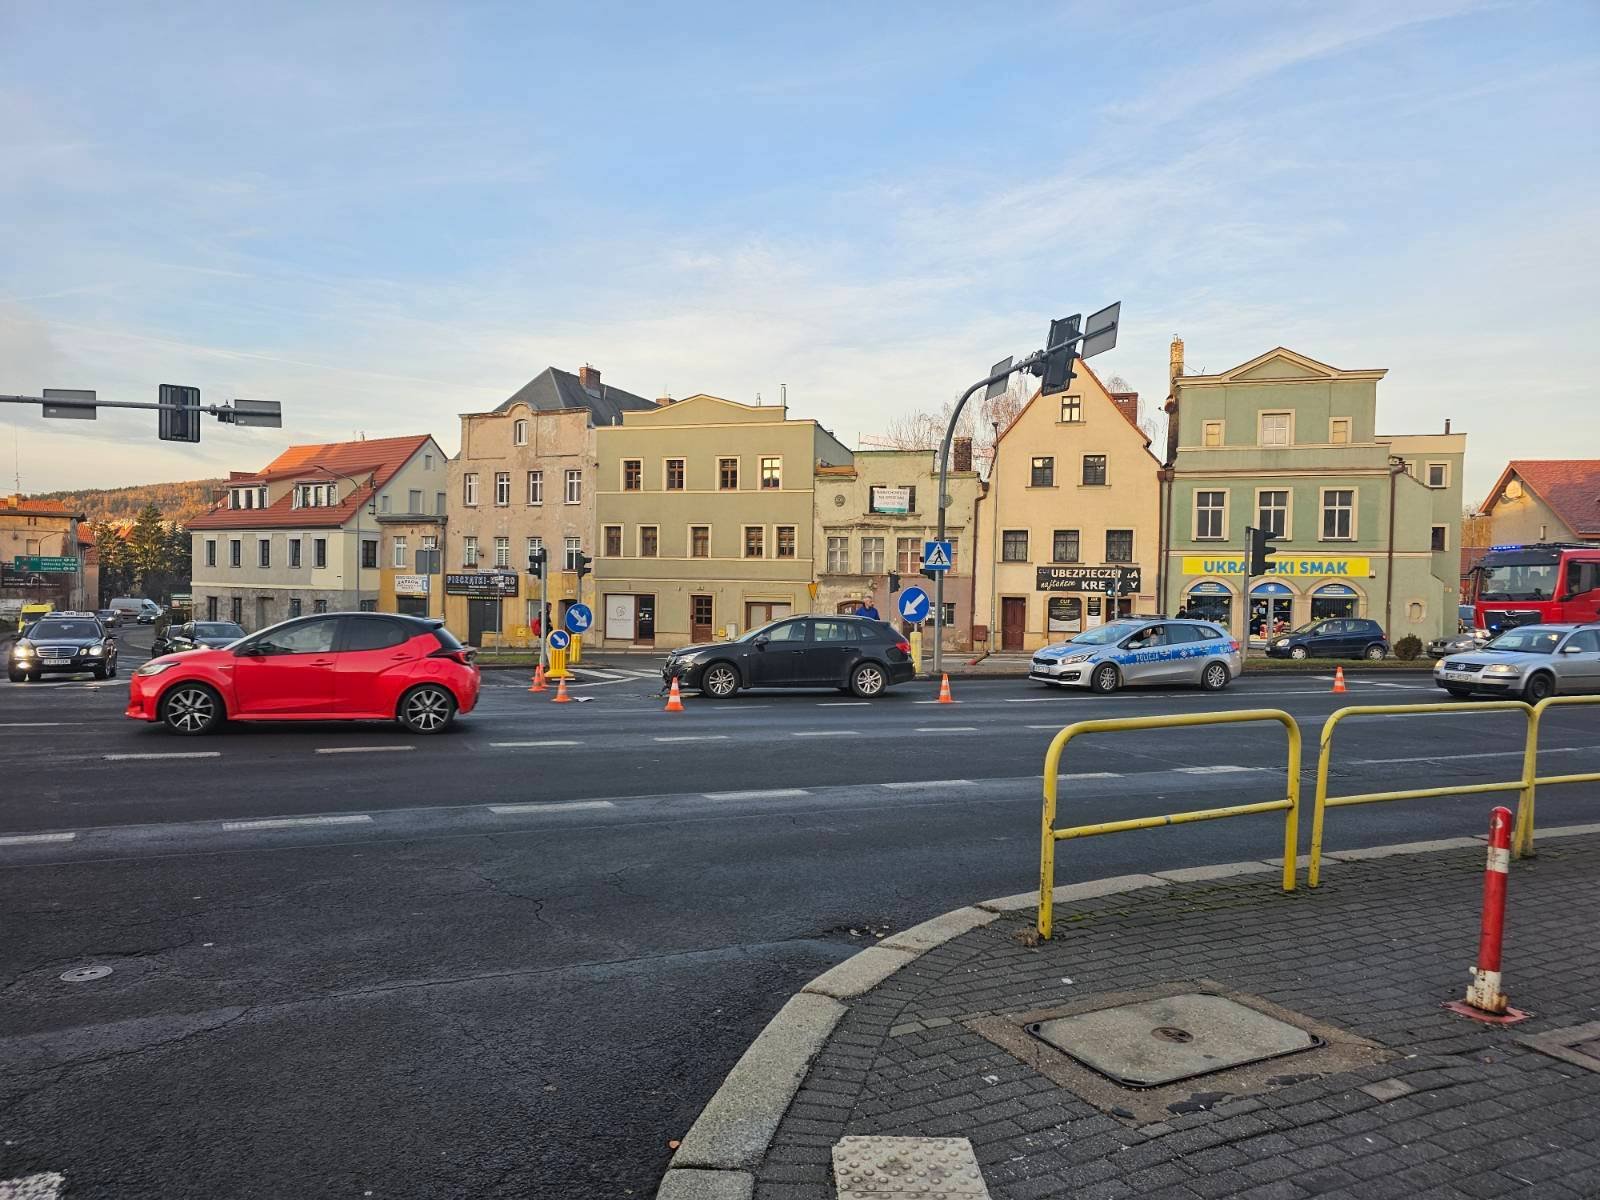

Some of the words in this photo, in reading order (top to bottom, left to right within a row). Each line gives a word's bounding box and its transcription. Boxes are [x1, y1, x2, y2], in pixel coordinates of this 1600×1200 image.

[1204, 560, 1294, 574] UKRAKI
[1300, 561, 1348, 575] SMAK
[1136, 652, 1159, 662] POLICJA
